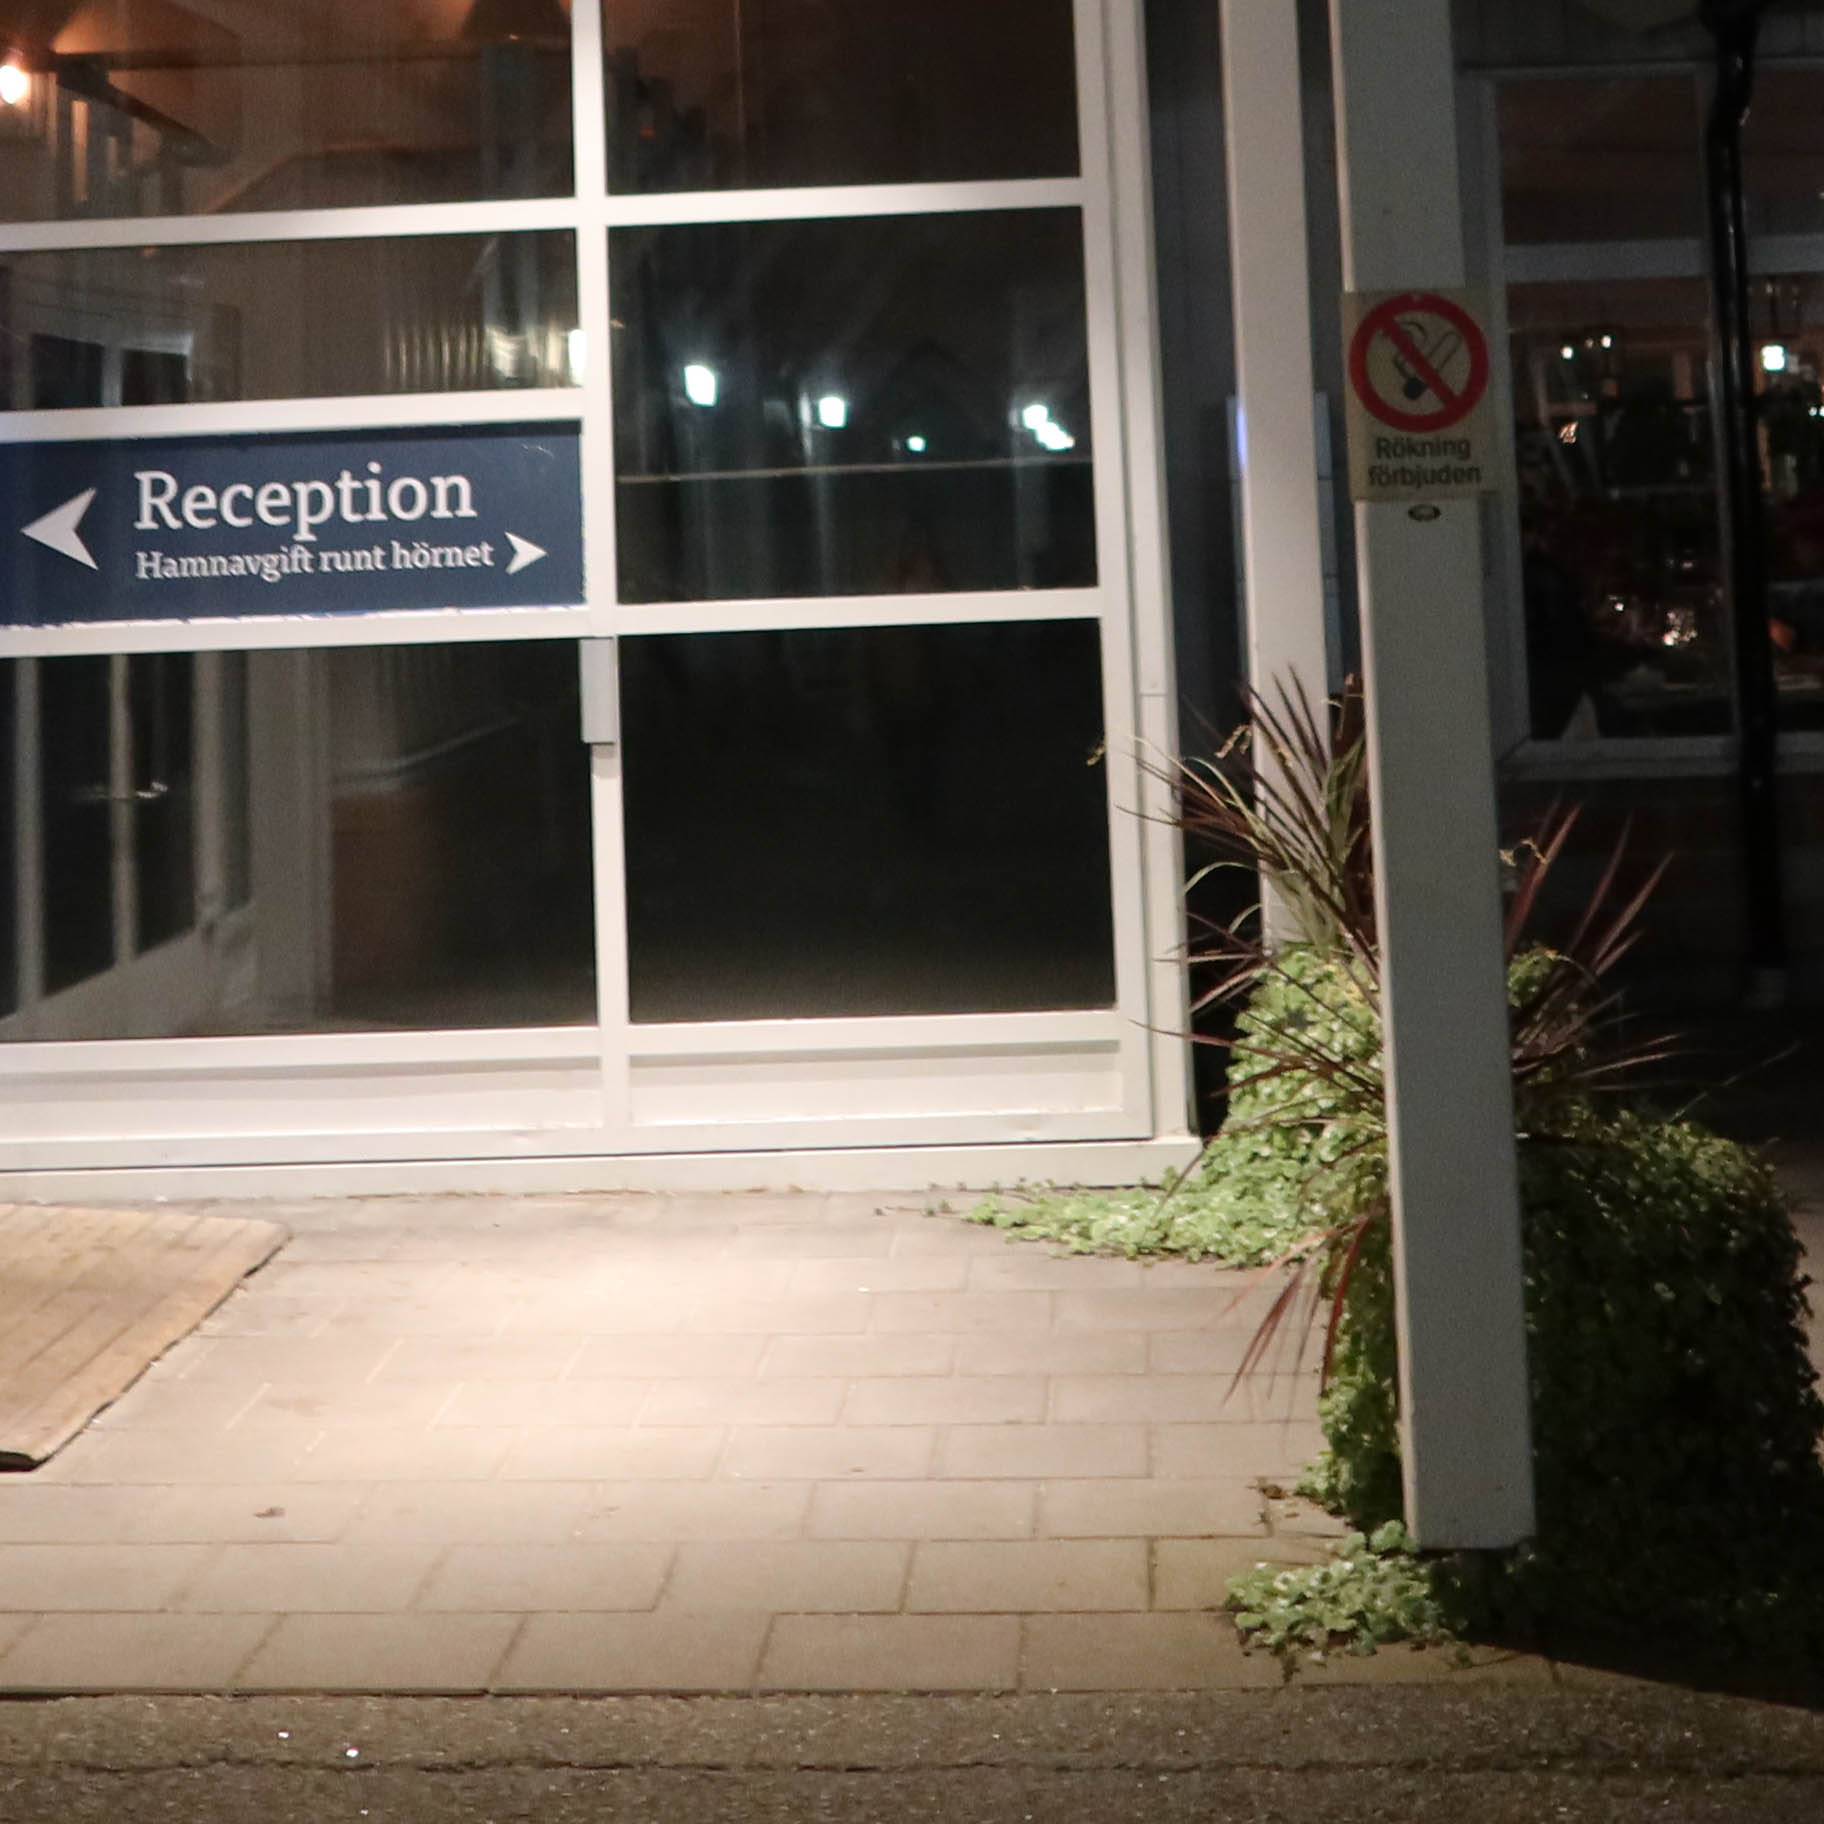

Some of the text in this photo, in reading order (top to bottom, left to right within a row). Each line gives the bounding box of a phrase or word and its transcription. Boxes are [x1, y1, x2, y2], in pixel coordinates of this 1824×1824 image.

[1376, 437, 1472, 461] Rökning
[1368, 465, 1481, 489] förbjuden
[133, 461, 477, 542] Reception
[136, 539, 495, 582] Hamnavgift runt hörnet
